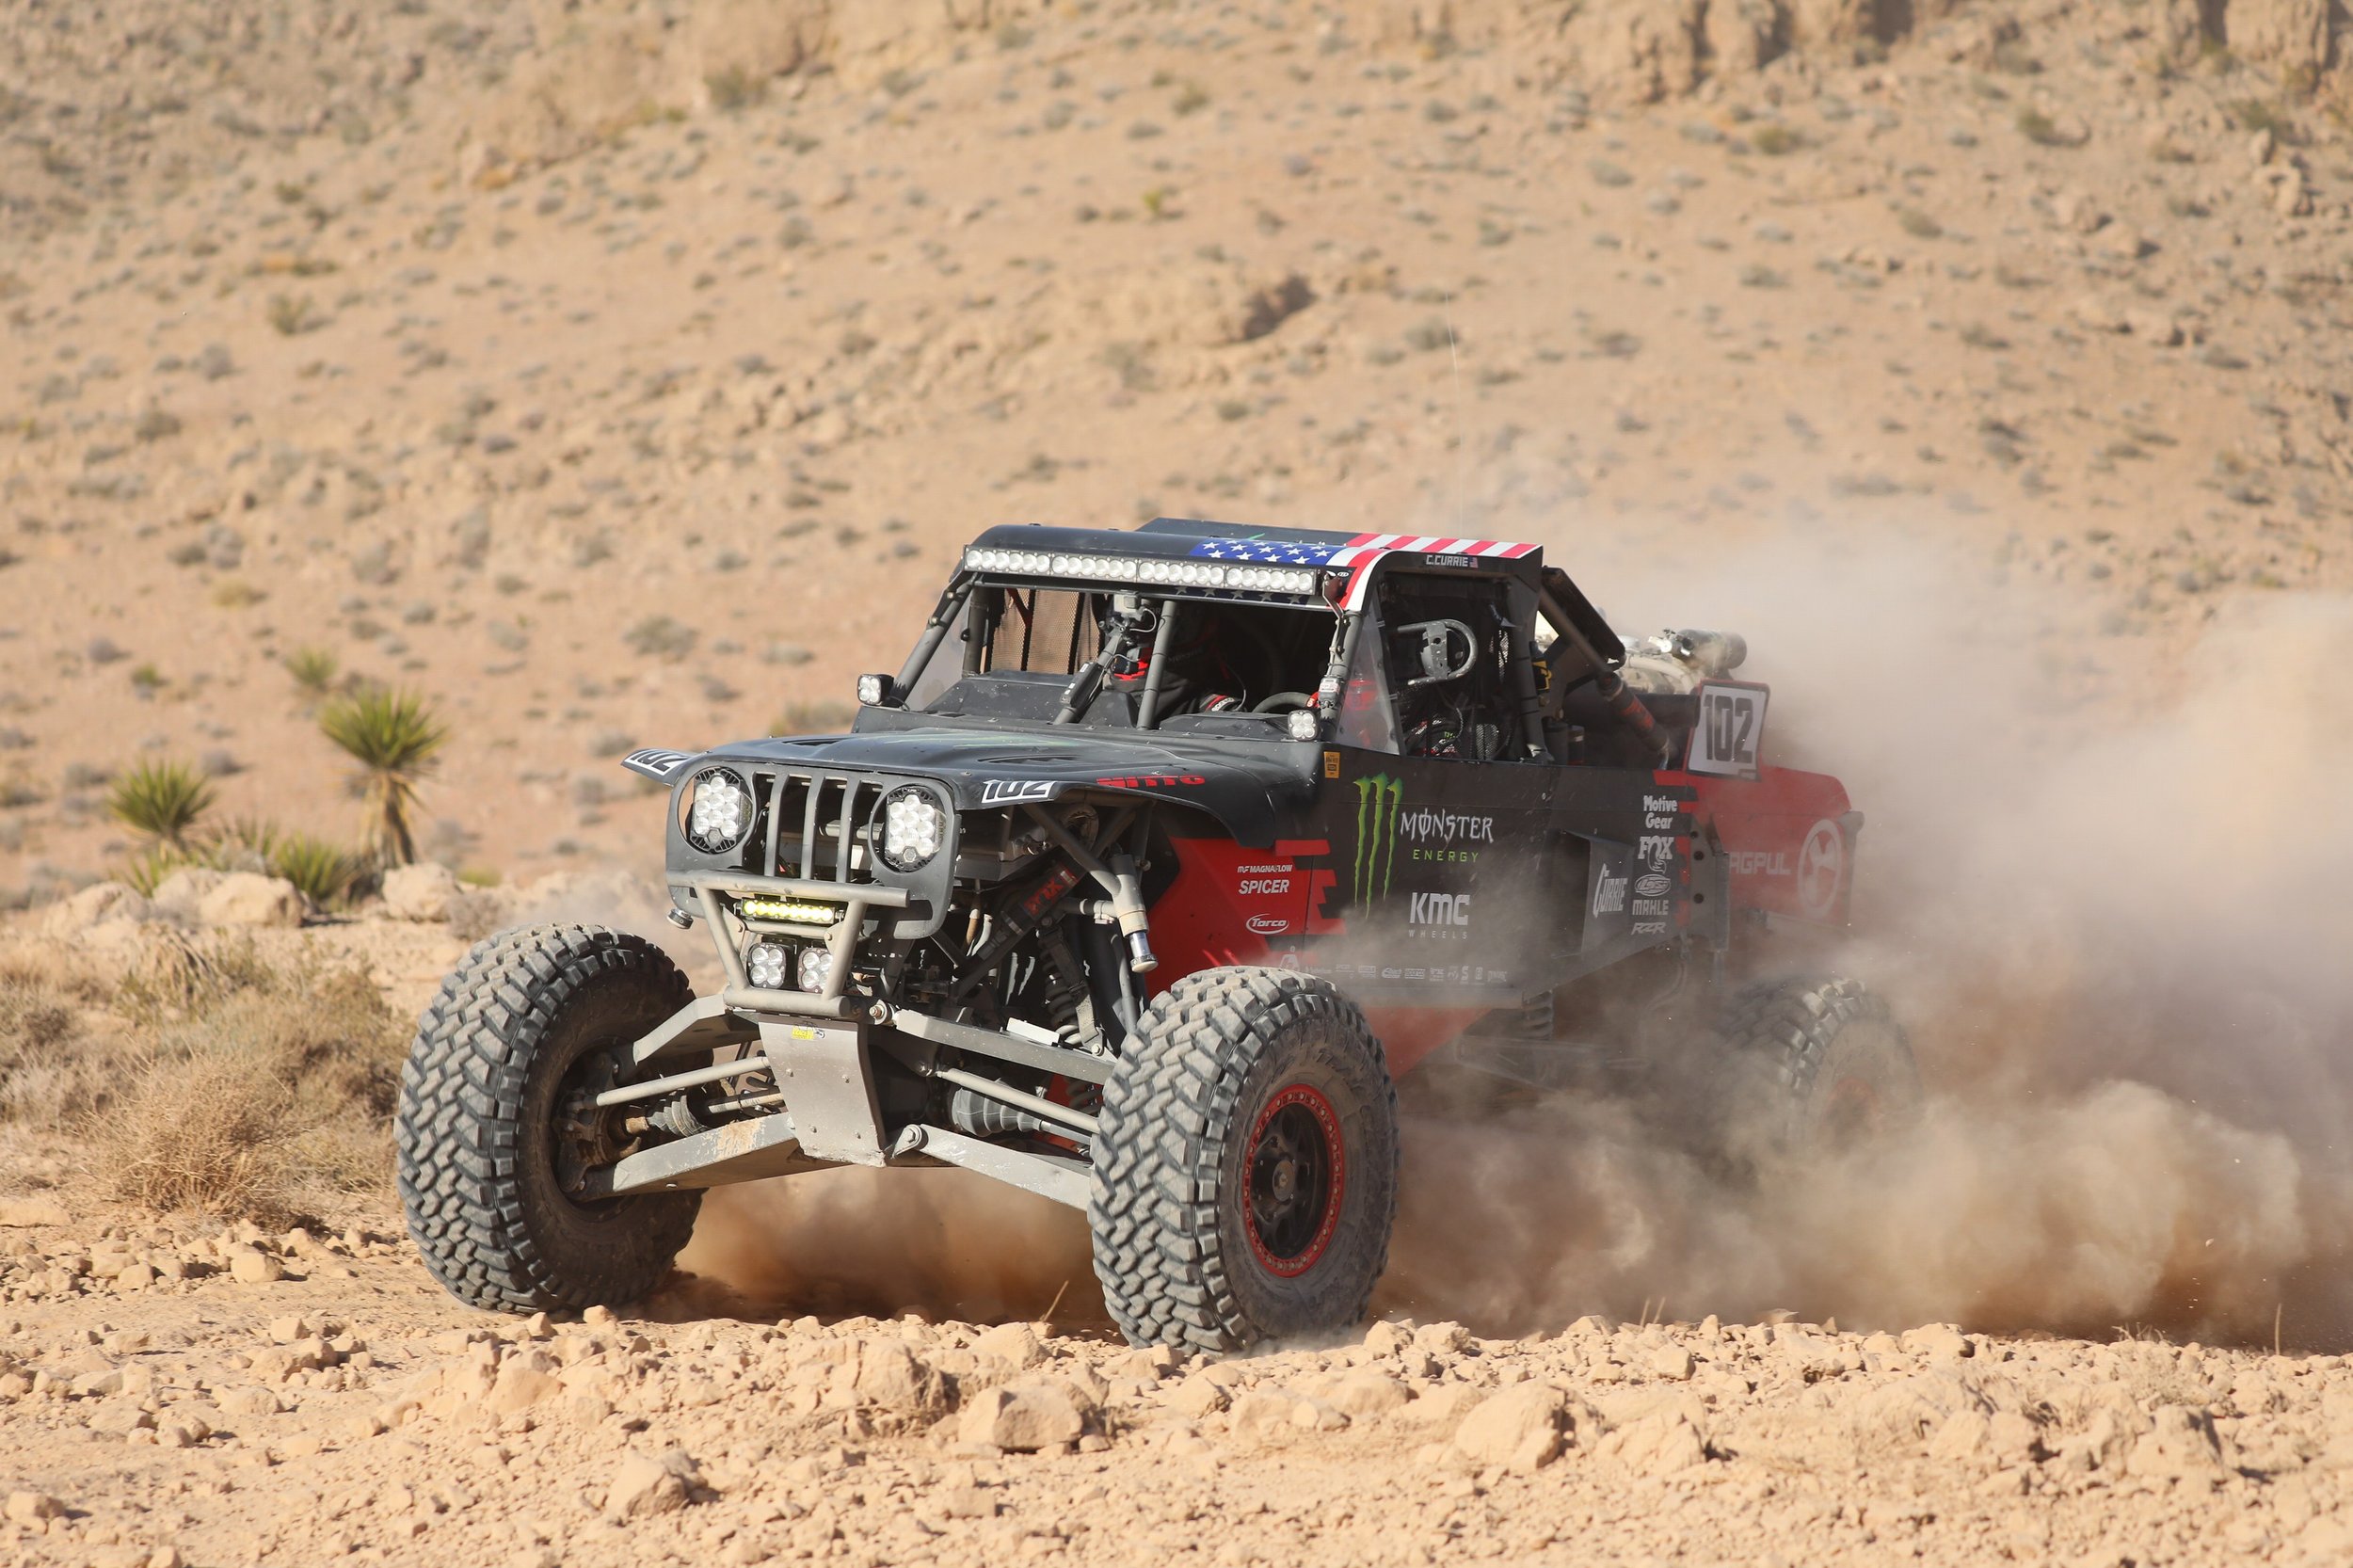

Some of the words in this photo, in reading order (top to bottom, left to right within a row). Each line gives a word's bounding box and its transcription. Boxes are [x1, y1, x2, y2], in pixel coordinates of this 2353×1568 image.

[1426, 554, 1468, 567] C.CURRIE
[1703, 694, 1753, 763] 102
[984, 780, 1051, 801] 102
[1643, 795, 1678, 812] Motive
[1645, 812, 1673, 829] Gear
[1413, 849, 1480, 863] ENERGY
[1638, 835, 1674, 870] FOX
[1729, 852, 1791, 875] AGPUL
[1238, 879, 1289, 895] SPICER
[1409, 891, 1471, 925] KMC
[1632, 899, 1670, 916] MAHLE
[1252, 918, 1288, 927] Torco
[1631, 921, 1667, 936] RZR
[1408, 929, 1468, 939] WHEELS
